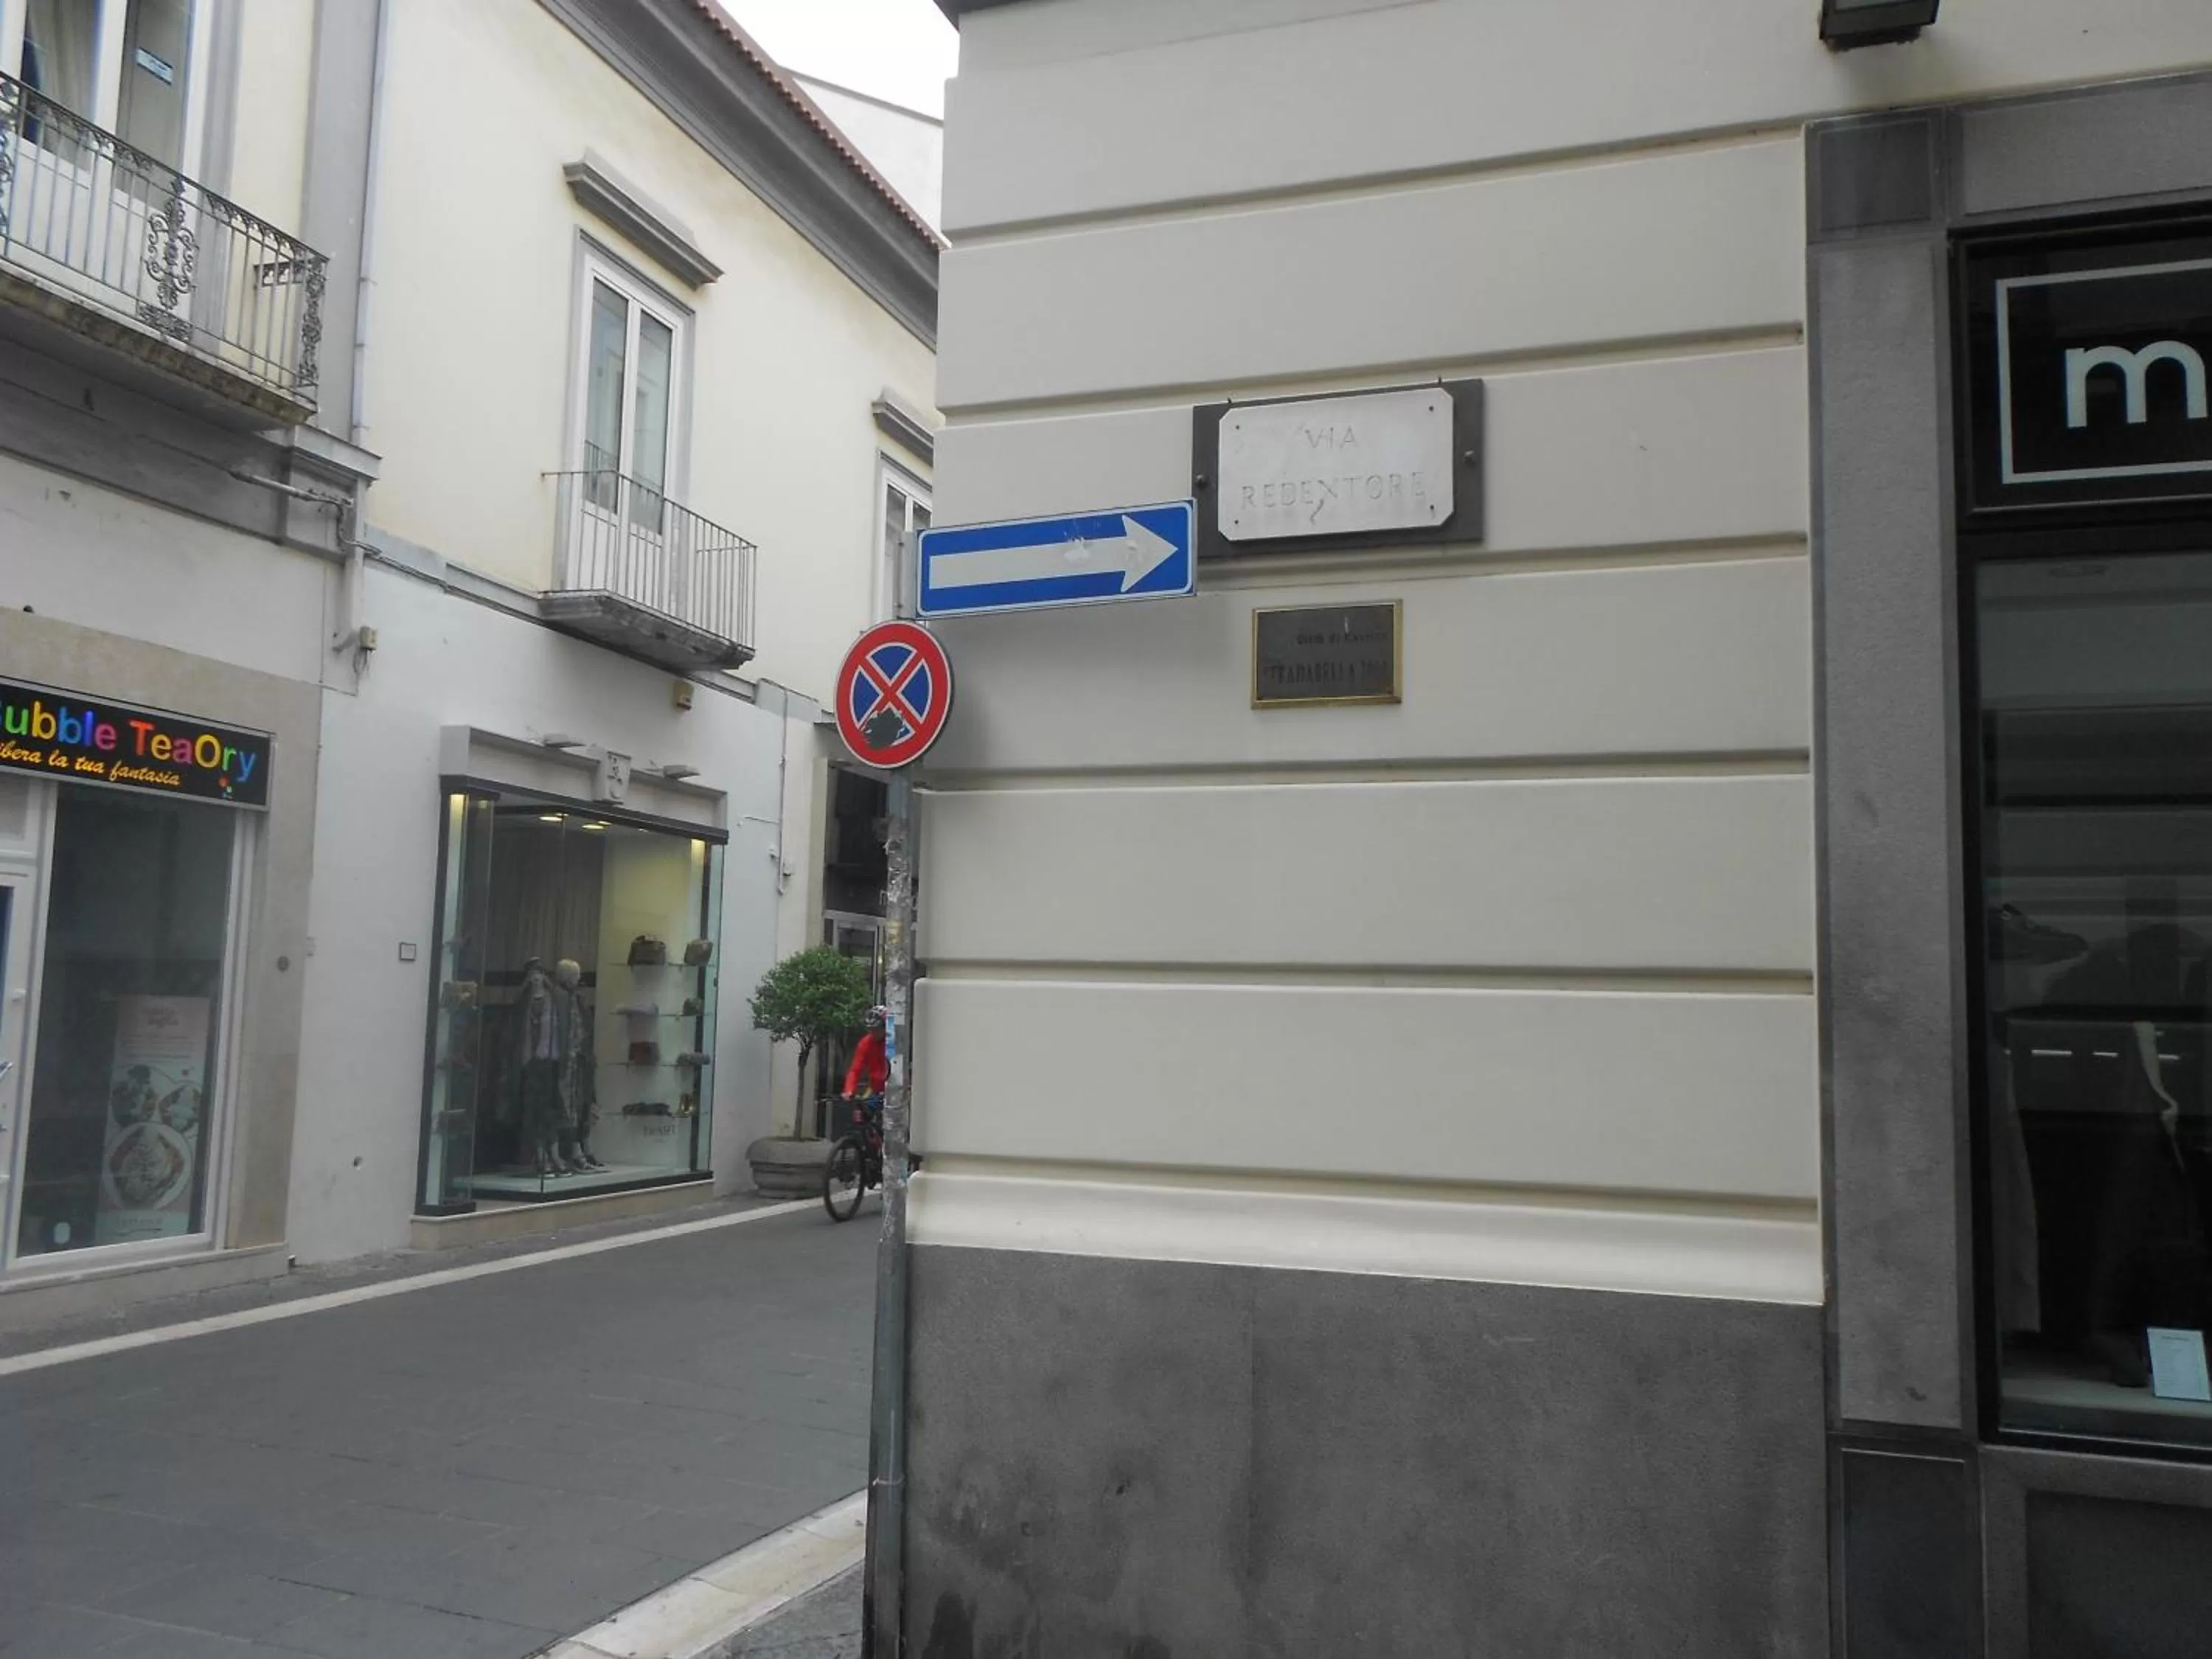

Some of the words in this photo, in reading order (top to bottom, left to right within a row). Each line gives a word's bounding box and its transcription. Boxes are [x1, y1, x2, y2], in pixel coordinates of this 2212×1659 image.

[1304, 425, 1358, 450] VIA
[1241, 471, 1425, 510] REDENTORE
[0, 700, 116, 750] ubble
[129, 719, 257, 782] TeaOry
[48, 748, 69, 768] la
[74, 756, 105, 773] tua
[108, 760, 181, 786] fantasia
